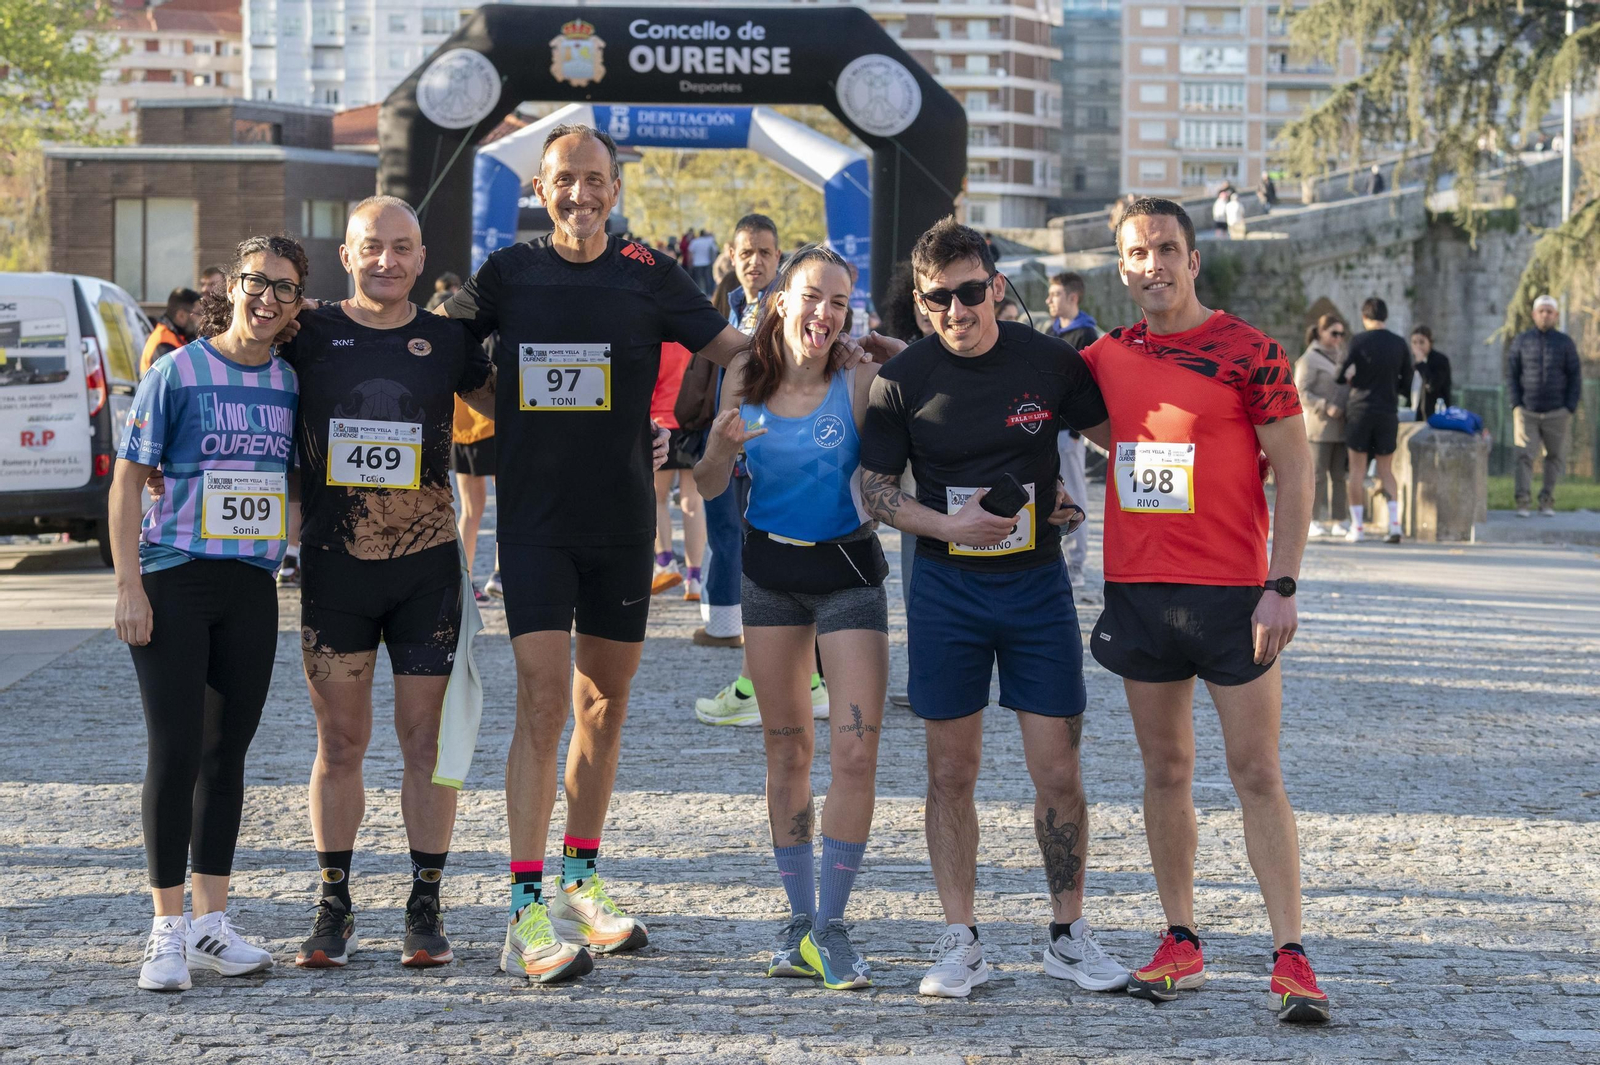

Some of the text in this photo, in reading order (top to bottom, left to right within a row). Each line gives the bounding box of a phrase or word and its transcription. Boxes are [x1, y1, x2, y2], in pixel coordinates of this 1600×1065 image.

[629, 19, 766, 40] Concello de
[628, 45, 791, 75] OURENSE
[679, 80, 743, 94] Deportes
[637, 110, 735, 126] DEPUTACIÓN
[636, 124, 709, 140] OURENSE
[547, 368, 581, 393] 97
[551, 397, 576, 405] TONI
[1010, 415, 1028, 423] FALA
[1033, 412, 1049, 420] LUTA
[201, 433, 292, 461] OURENSE
[346, 445, 401, 470] 469
[1128, 468, 1174, 494] 198
[222, 496, 271, 521] 509
[1136, 498, 1160, 508] RIVO
[232, 525, 260, 535] Sonia
